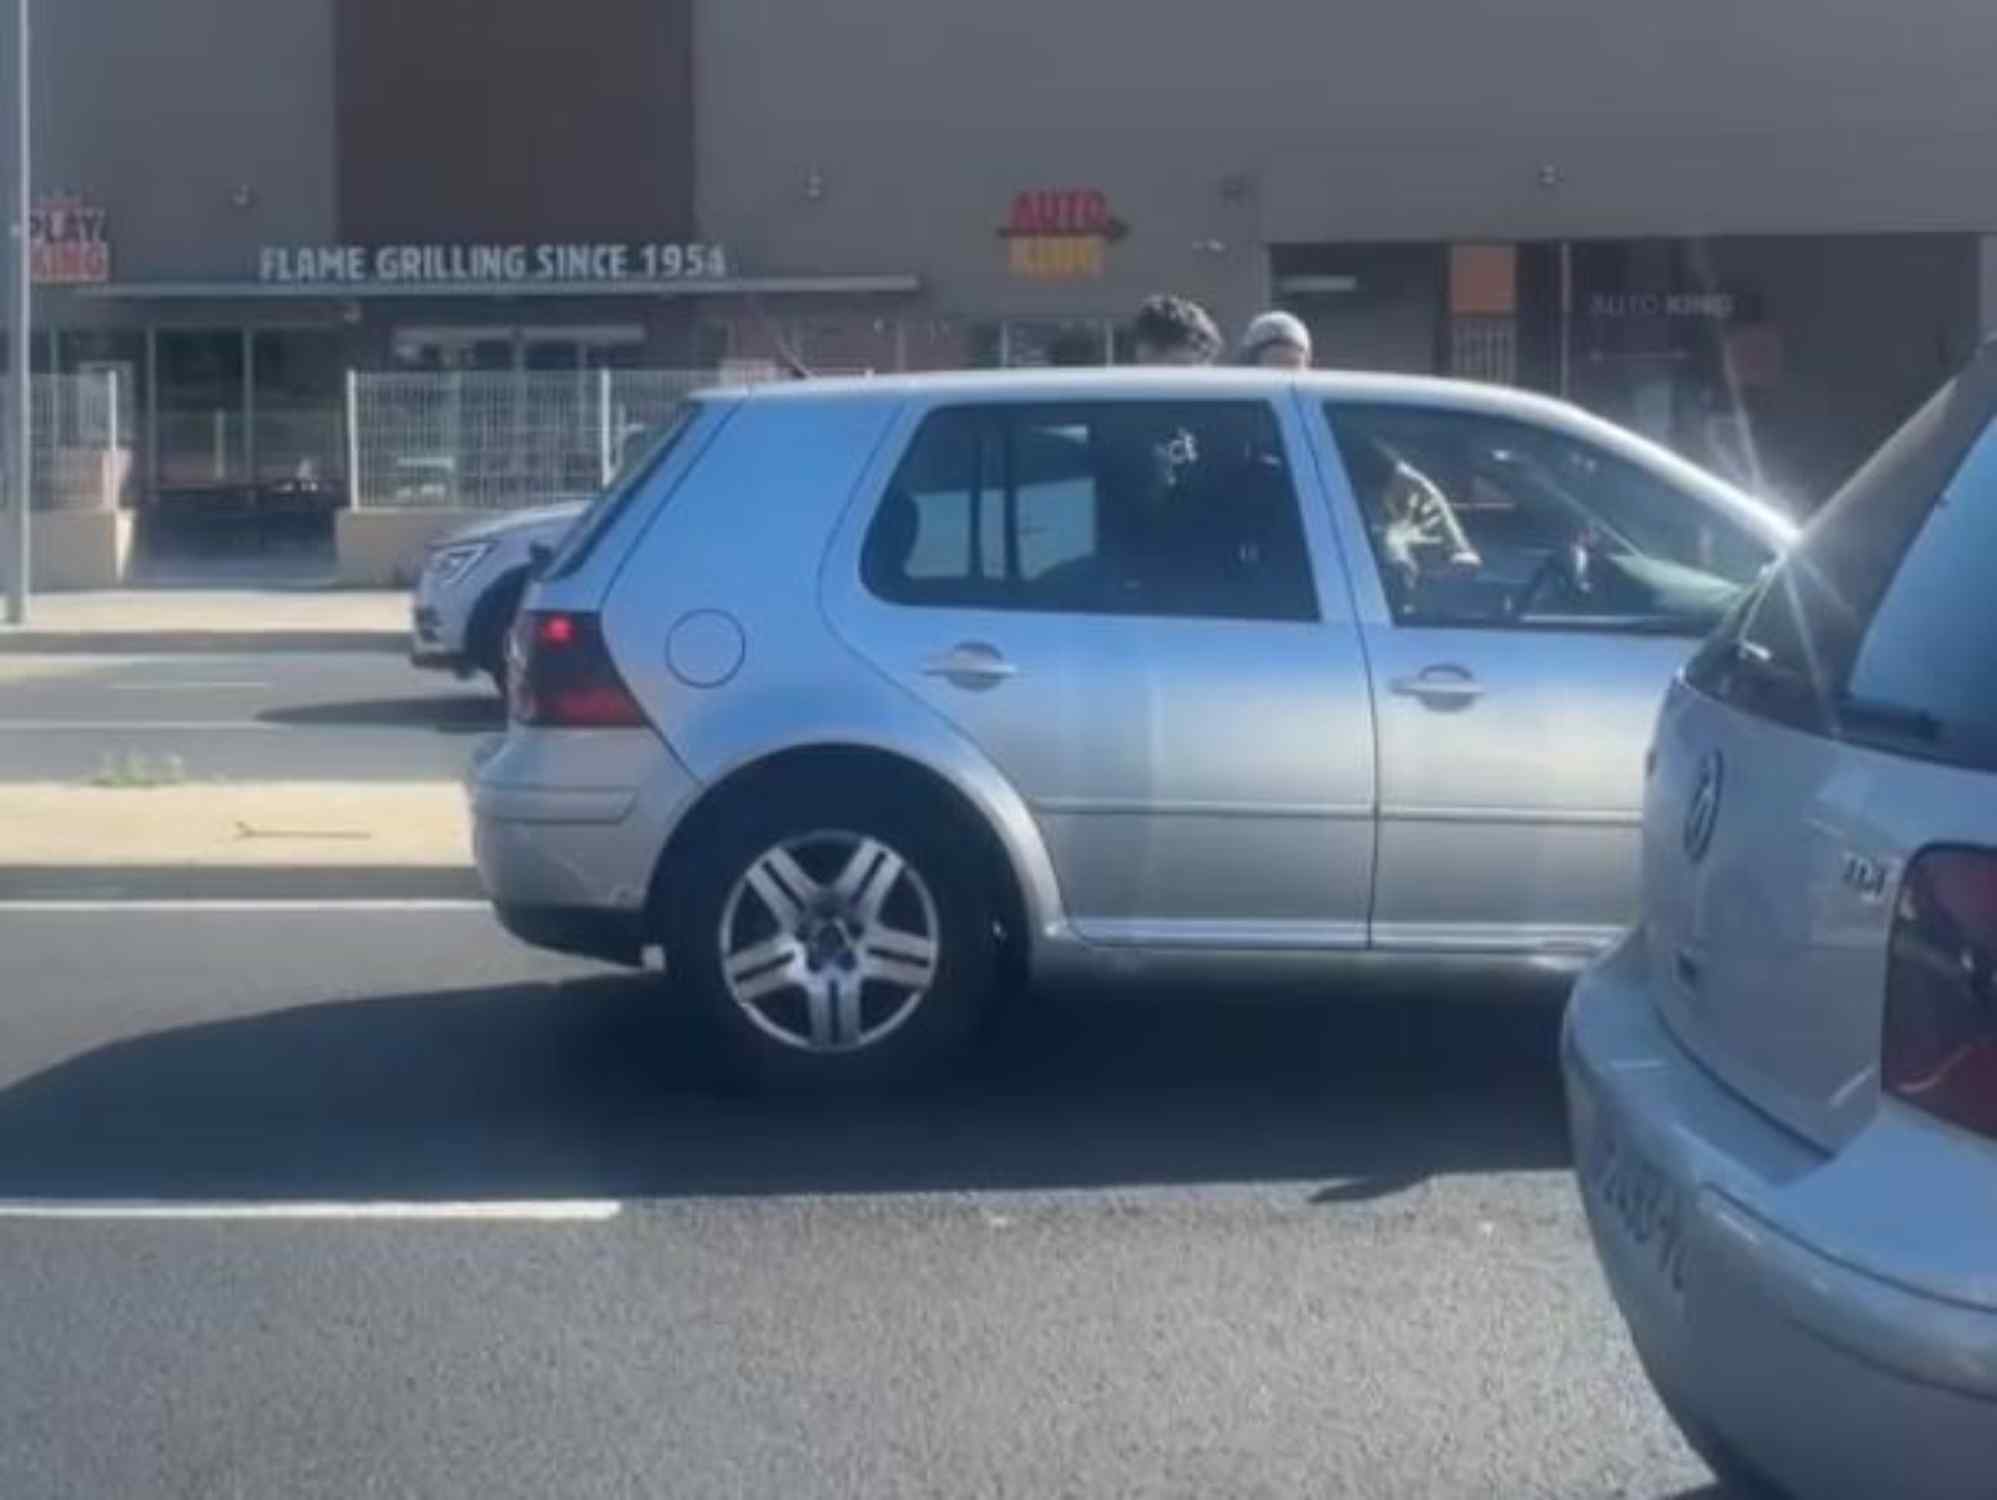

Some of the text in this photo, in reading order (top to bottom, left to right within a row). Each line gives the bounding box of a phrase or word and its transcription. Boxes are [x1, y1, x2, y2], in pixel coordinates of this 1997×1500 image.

[259, 246, 365, 281] FLAME
[376, 246, 527, 281] GRILLING
[534, 244, 628, 279] SINCE
